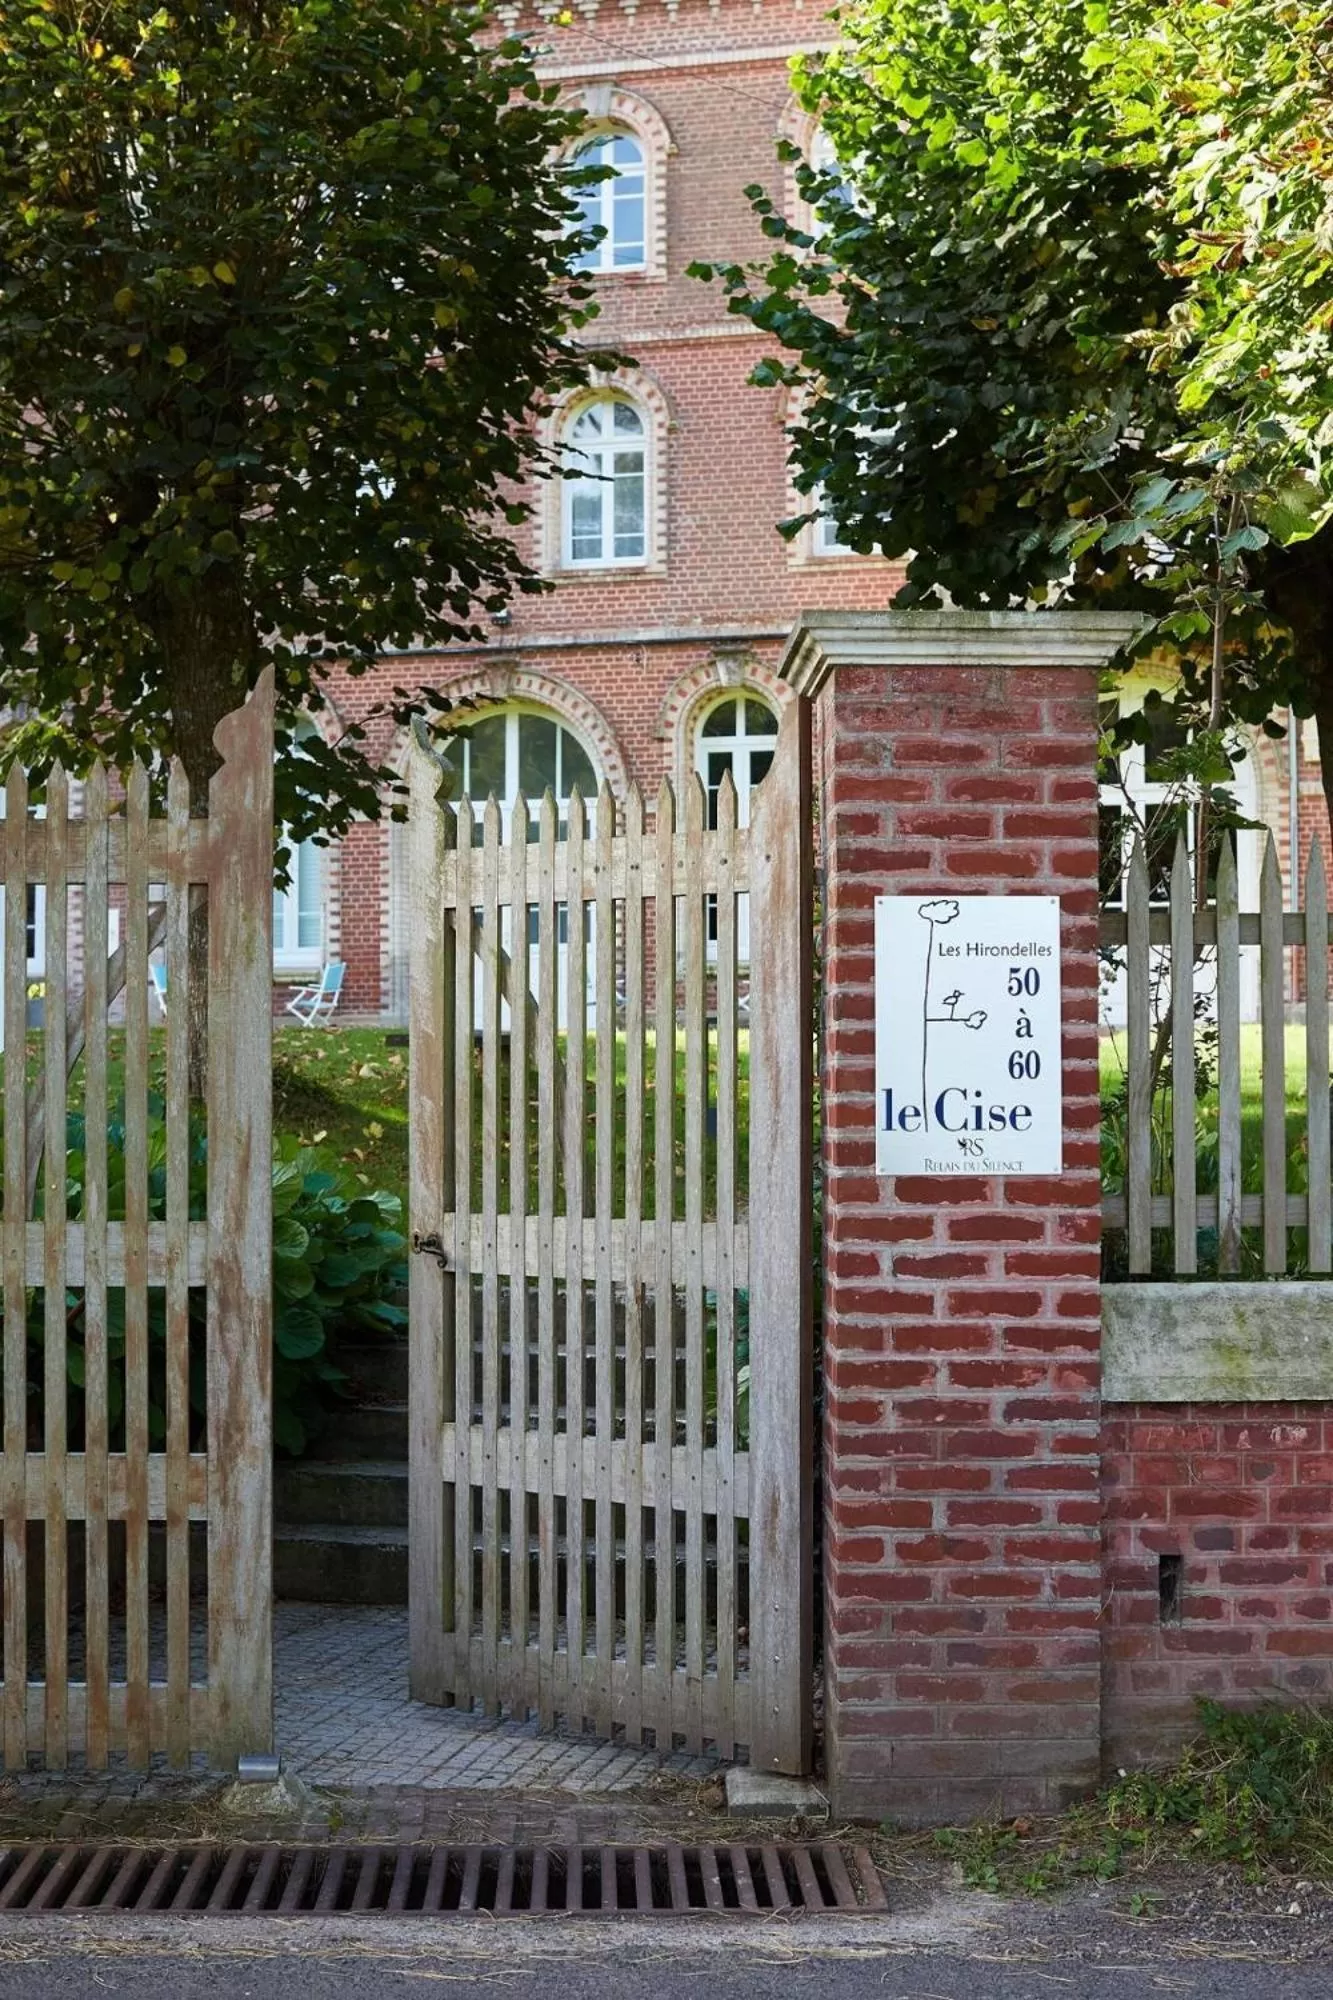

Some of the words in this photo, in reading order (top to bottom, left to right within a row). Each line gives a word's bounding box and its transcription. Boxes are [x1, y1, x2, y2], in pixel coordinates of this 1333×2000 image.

[938, 942, 960, 957] Les
[966, 942, 1052, 957] Hirondelles
[1007, 967, 1040, 997] 50
[1015, 1008, 1033, 1038] à
[1008, 1050, 1041, 1080] 60
[881, 1088, 921, 1132] le
[934, 1087, 1033, 1132] Cise
[982, 1158, 1024, 1171] SILENCE
